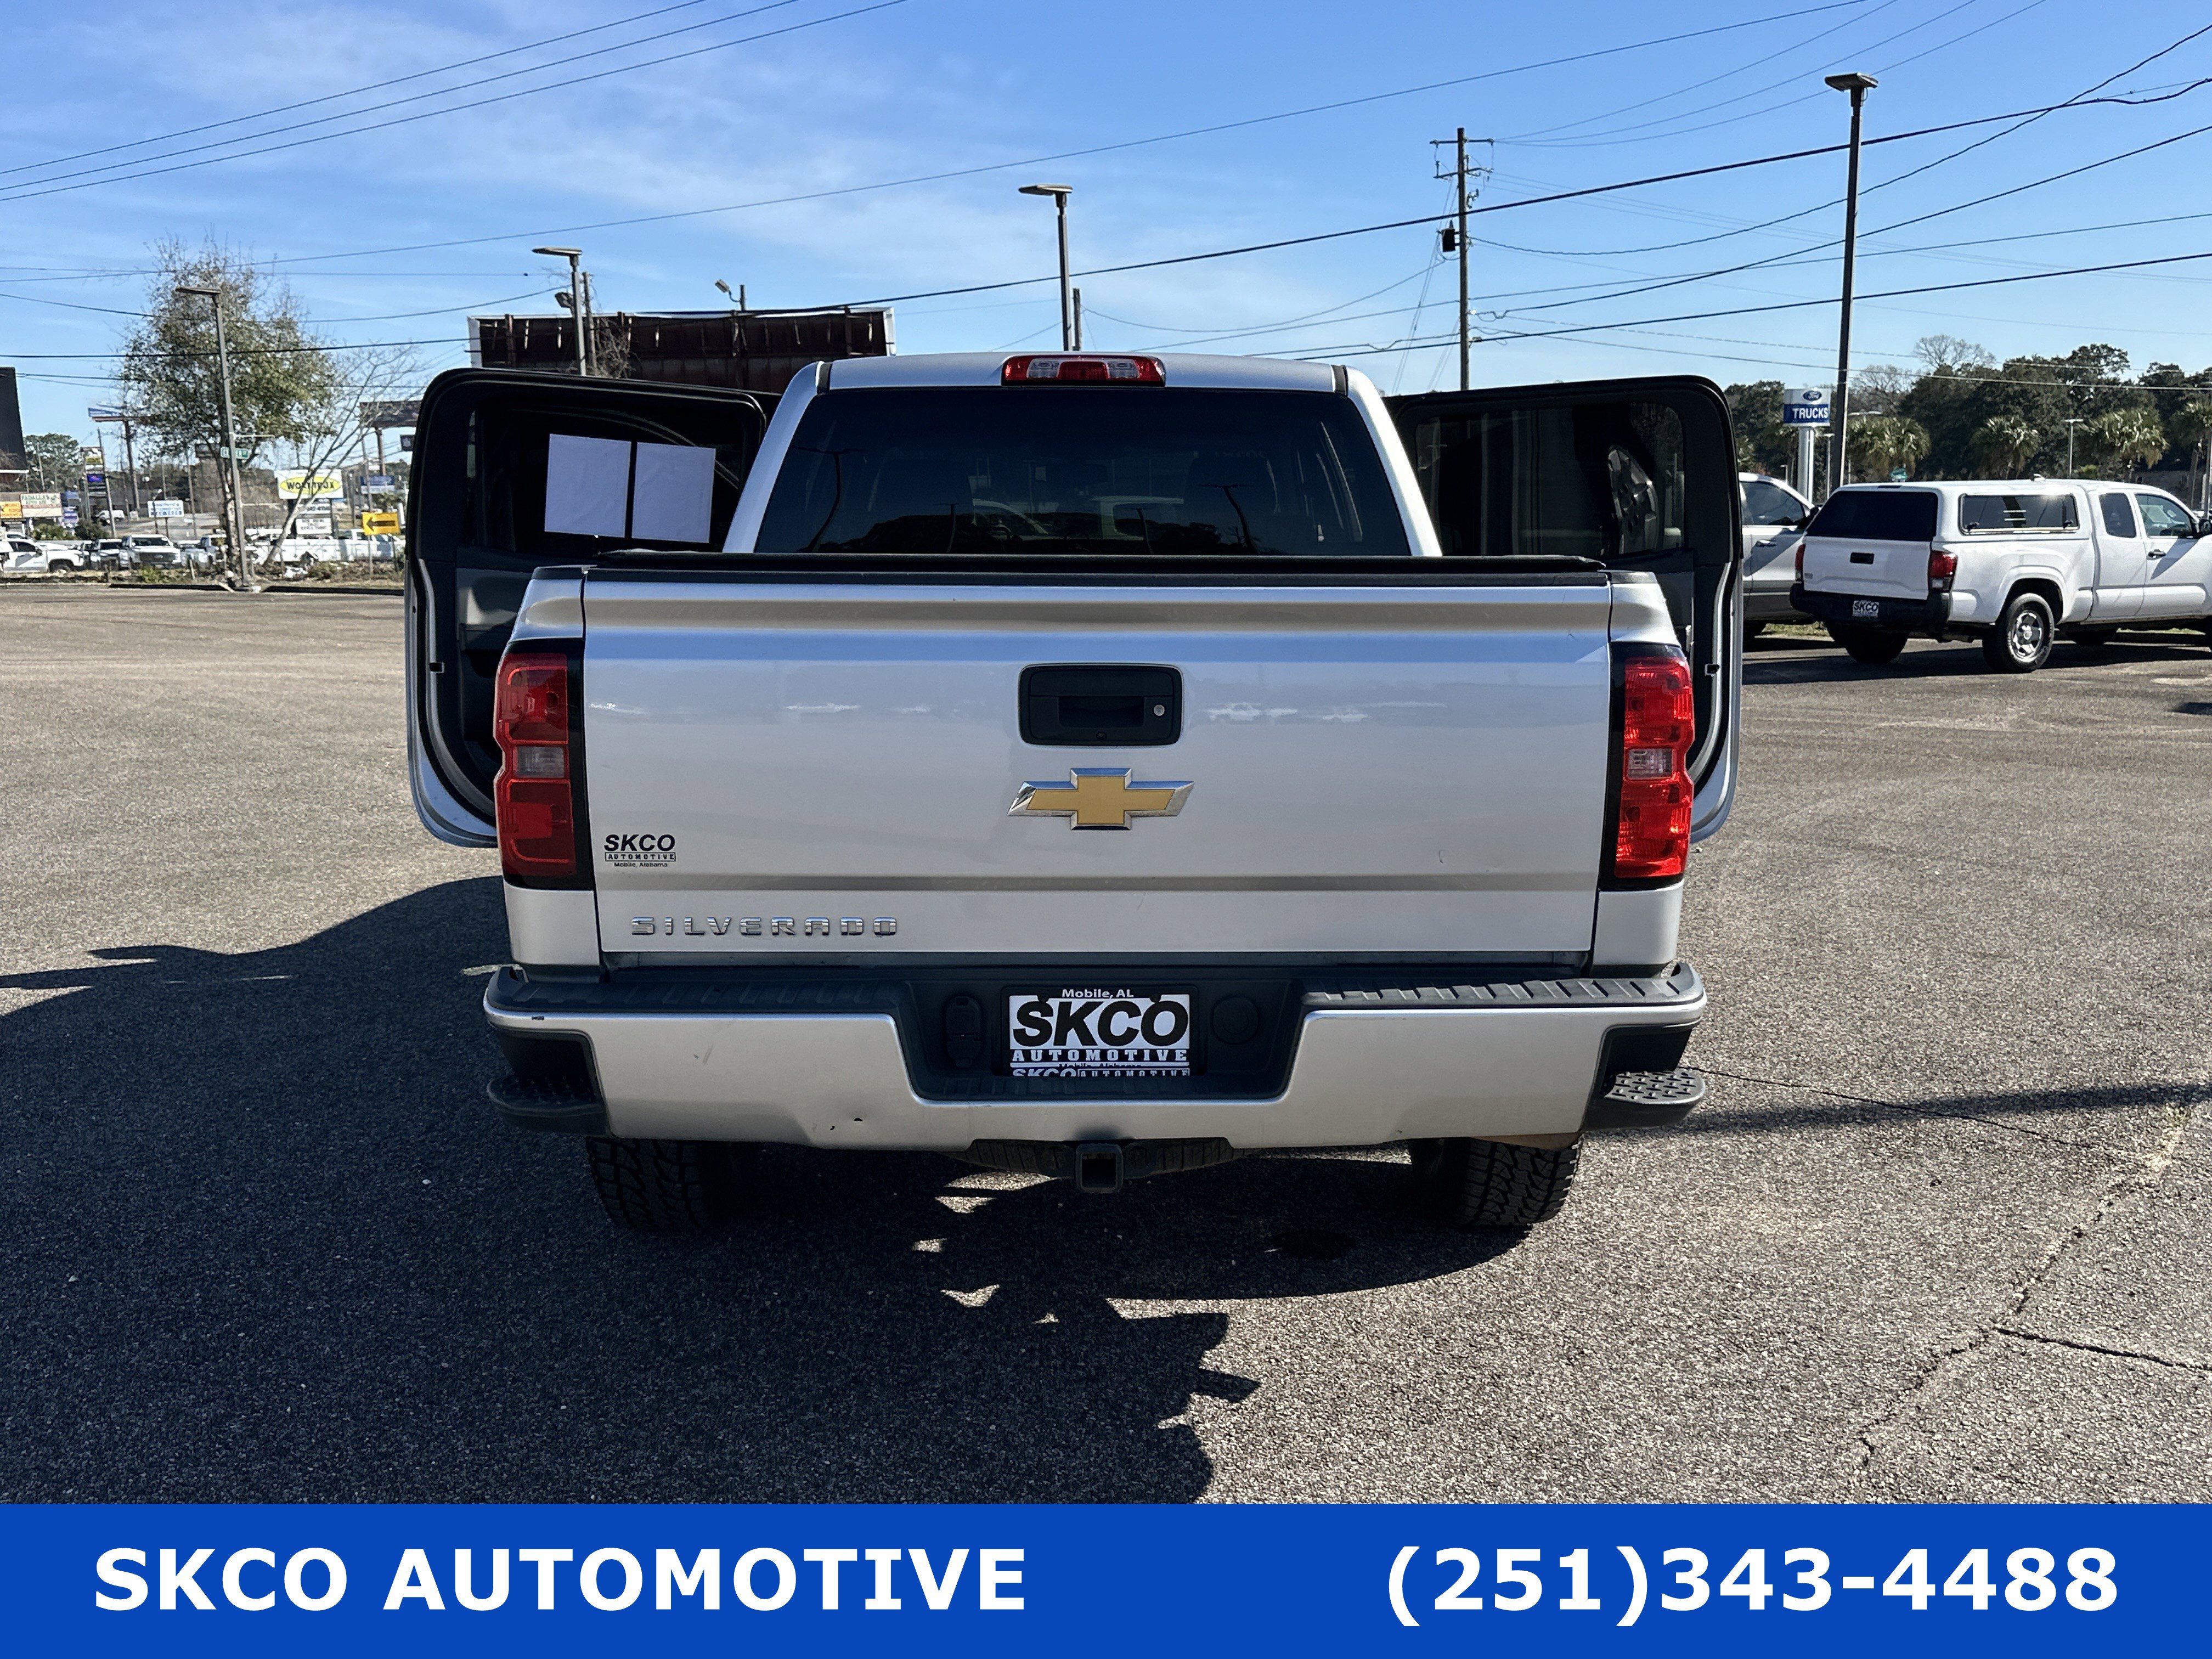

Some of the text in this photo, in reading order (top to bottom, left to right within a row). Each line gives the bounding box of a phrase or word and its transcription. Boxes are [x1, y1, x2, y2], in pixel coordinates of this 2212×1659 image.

[1792, 408, 1829, 419] TRUCKS
[1854, 602, 1878, 611] SKCO
[604, 834, 675, 851] SKCO
[631, 917, 898, 936] SILVERADO
[1062, 989, 1134, 999] Mobile, AL
[1013, 1001, 1188, 1047] SKCO
[1012, 1049, 1187, 1061] AUTOMOTIVE
